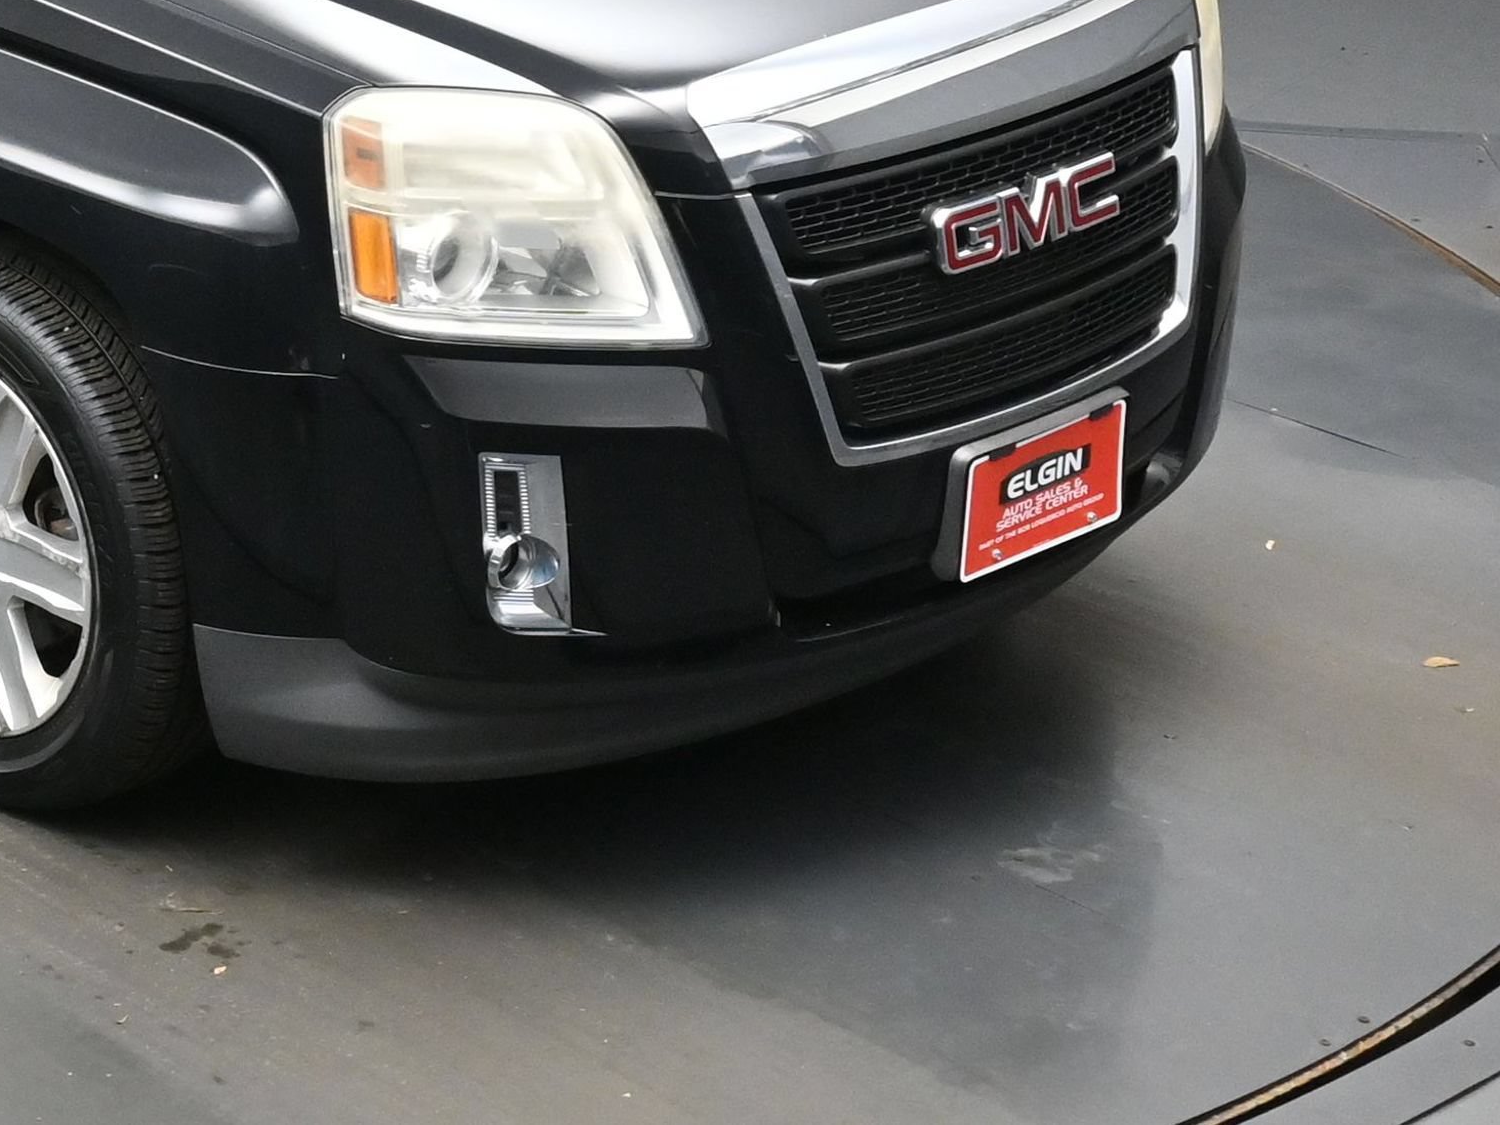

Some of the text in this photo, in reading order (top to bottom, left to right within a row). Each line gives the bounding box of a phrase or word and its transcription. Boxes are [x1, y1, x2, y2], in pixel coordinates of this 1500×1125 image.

[932, 151, 1120, 274] GMC
[1007, 447, 1083, 499] ELGIN
[996, 502, 1043, 533] SERVICE
[1045, 484, 1088, 510] CENTER
[1002, 498, 1033, 520] AUTO
[1035, 481, 1071, 503] SALES
[1074, 477, 1083, 489] &
